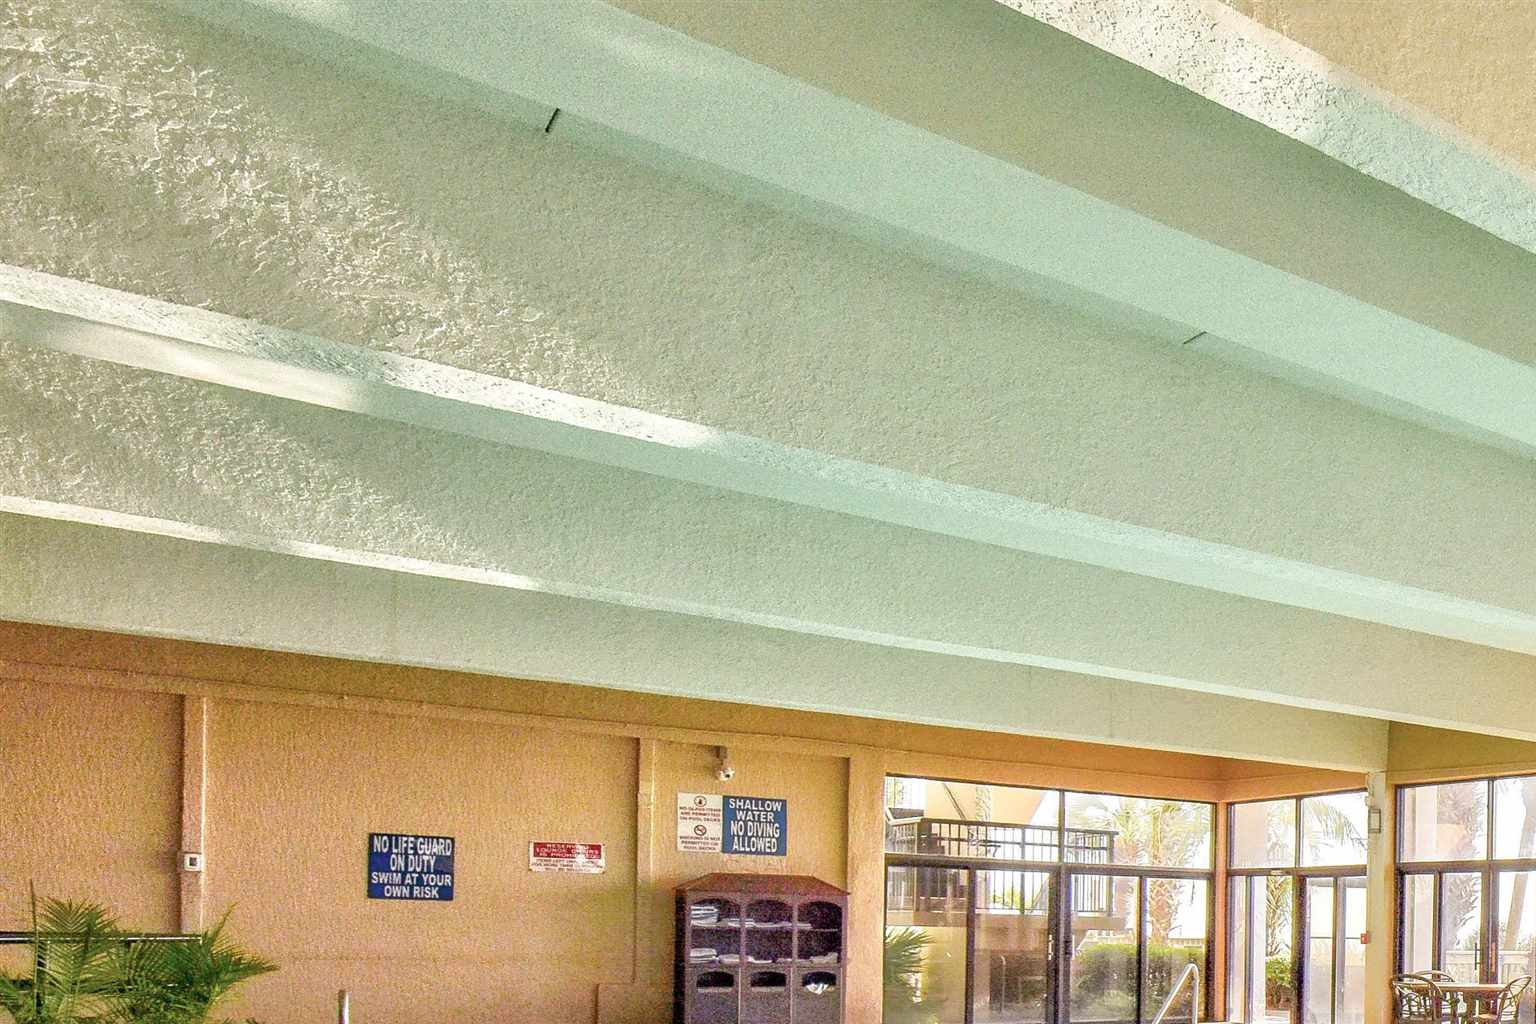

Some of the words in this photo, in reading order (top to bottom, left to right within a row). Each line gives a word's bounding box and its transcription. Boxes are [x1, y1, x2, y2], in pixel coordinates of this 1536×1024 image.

[729, 798, 782, 811] SHALLOW
[736, 810, 774, 822] WATER
[730, 821, 745, 836] NO
[747, 821, 780, 838] DIVING
[373, 835, 390, 853] NO
[391, 836, 415, 854] LIFE
[417, 838, 452, 856] GUARD
[732, 837, 777, 852] ALLOWED
[390, 854, 405, 871] ON
[407, 855, 436, 872] DUTY
[371, 872, 401, 884] SWIM
[404, 873, 419, 885] AT
[422, 874, 452, 886] YOUR
[384, 885, 410, 897] OWN
[413, 886, 439, 898] RISK
